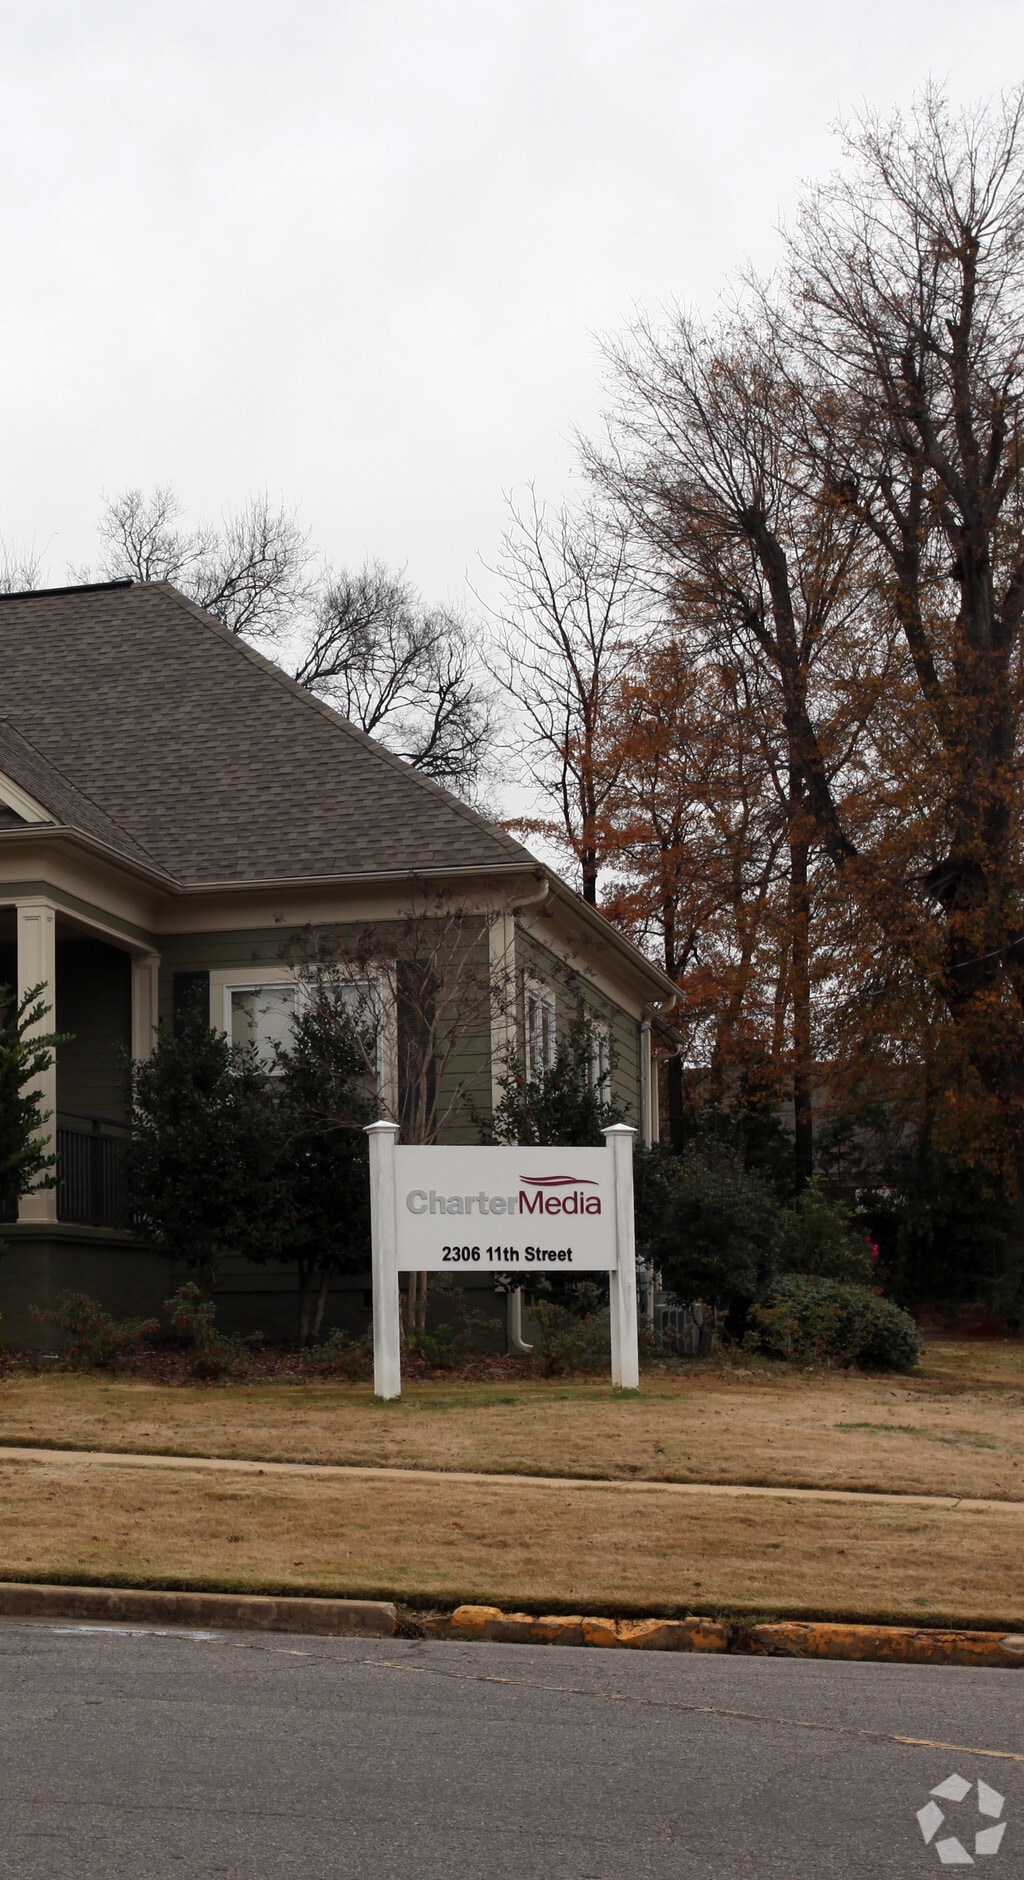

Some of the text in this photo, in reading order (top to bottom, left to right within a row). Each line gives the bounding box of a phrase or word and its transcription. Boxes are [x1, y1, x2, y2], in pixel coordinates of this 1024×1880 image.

[406, 1189, 602, 1215] CharterMedia
[442, 1246, 573, 1262] 2306 11th Street
